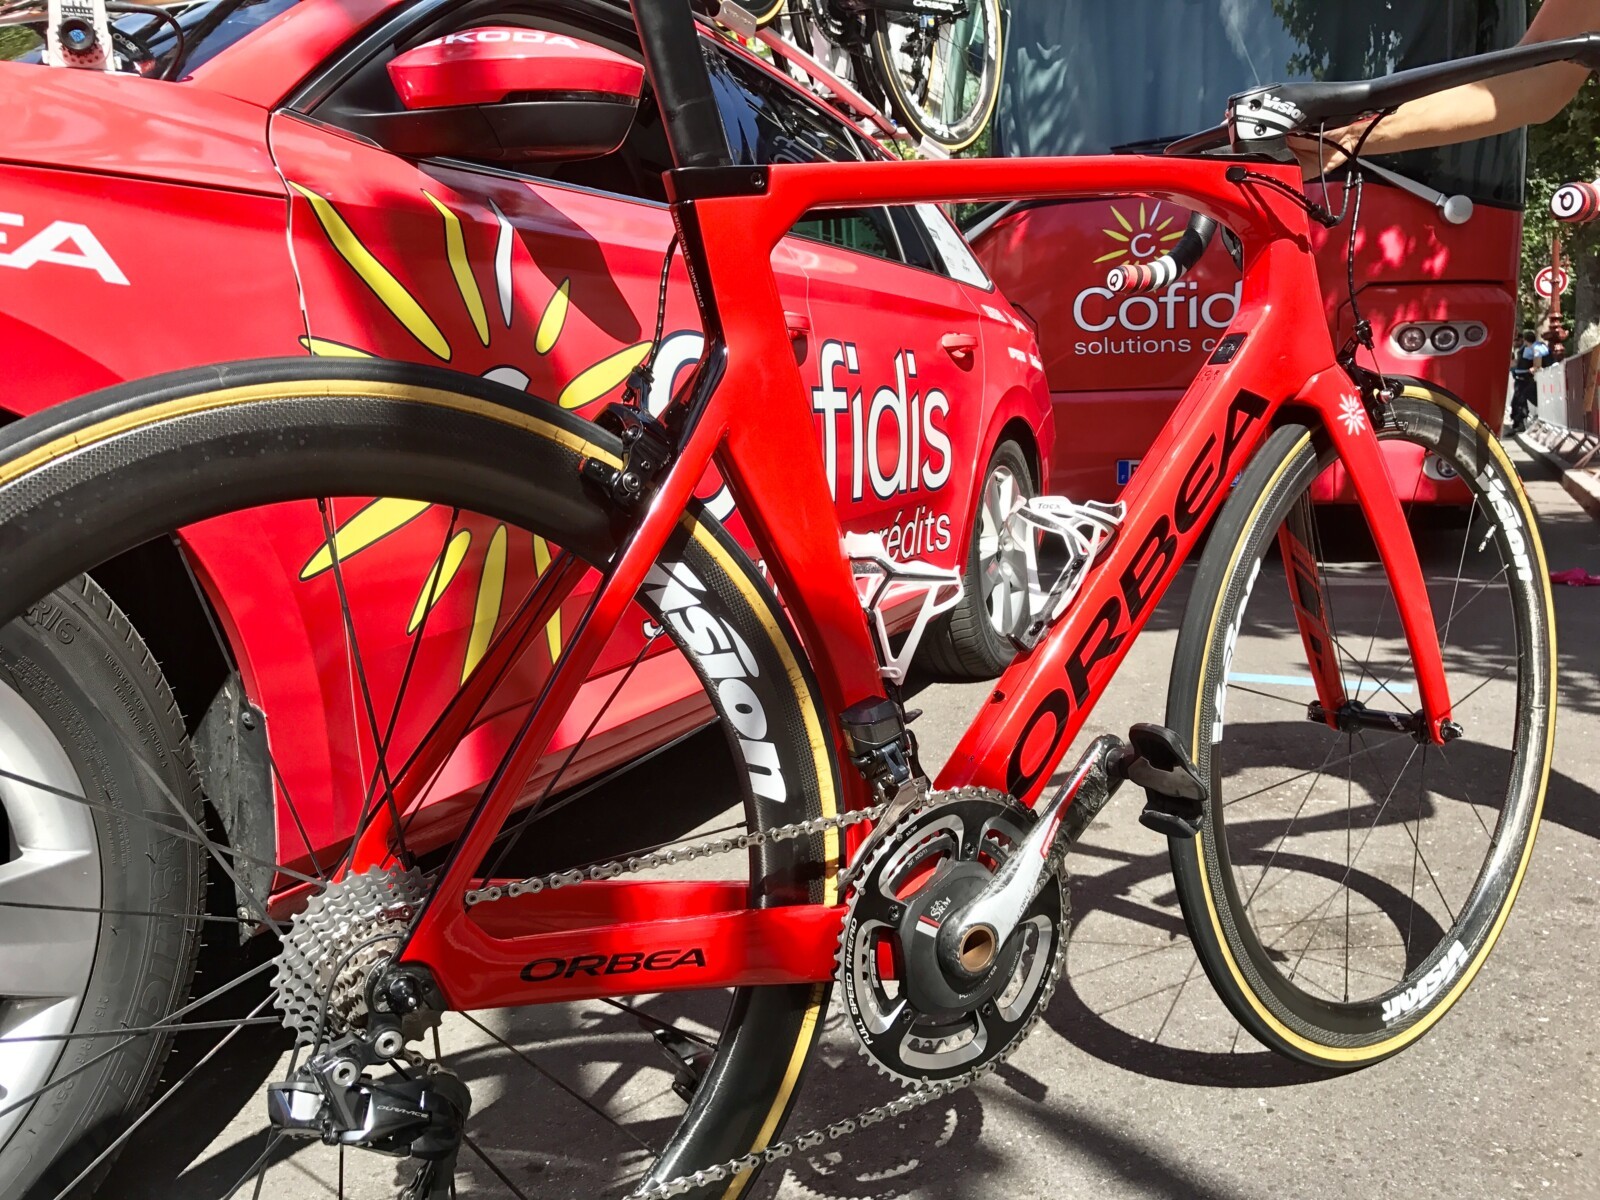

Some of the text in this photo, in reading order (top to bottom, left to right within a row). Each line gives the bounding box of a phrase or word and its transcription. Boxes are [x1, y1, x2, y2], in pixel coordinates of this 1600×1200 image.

[1074, 335, 1191, 355] solutions
[866, 504, 951, 560] rédits
[1007, 388, 1271, 797] ORBEA
[932, 897, 952, 922] SRM
[519, 947, 707, 982] ORBEA
[844, 917, 875, 1046] FULL SPEED AHEAD
